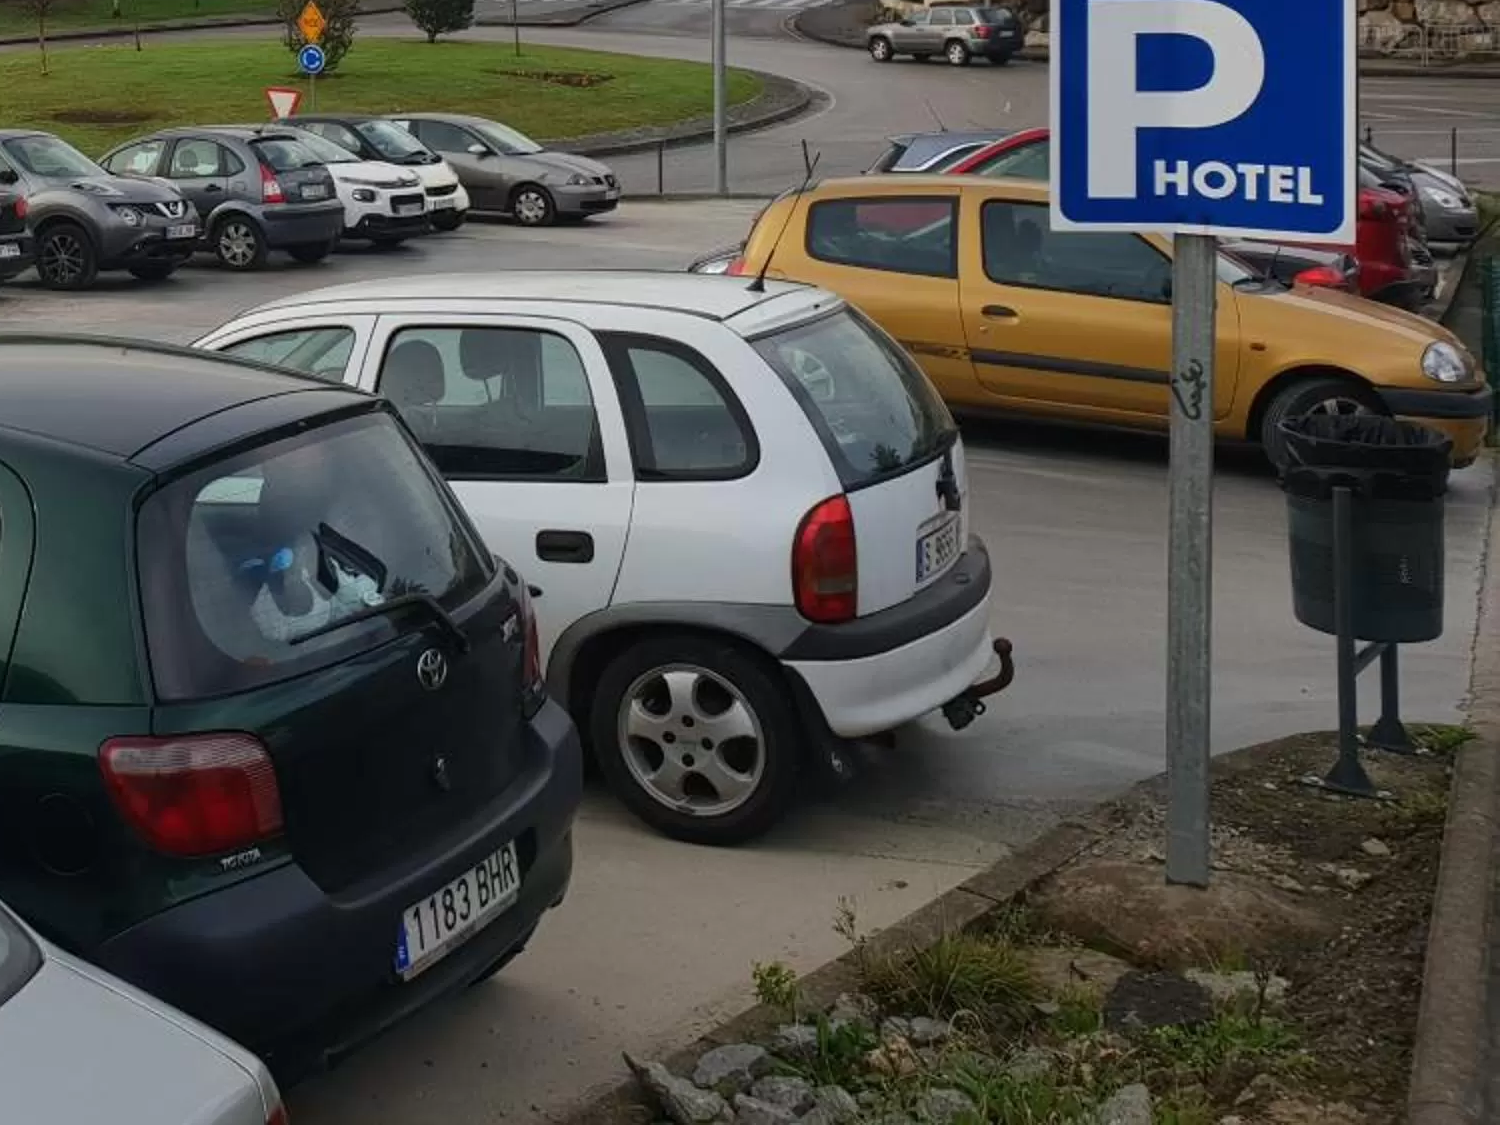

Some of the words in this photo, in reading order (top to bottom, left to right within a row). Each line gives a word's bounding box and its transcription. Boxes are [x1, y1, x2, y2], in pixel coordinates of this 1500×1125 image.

[1154, 160, 1324, 205] HOTEL
[413, 878, 471, 951] 1183
[475, 846, 515, 908] BHR
